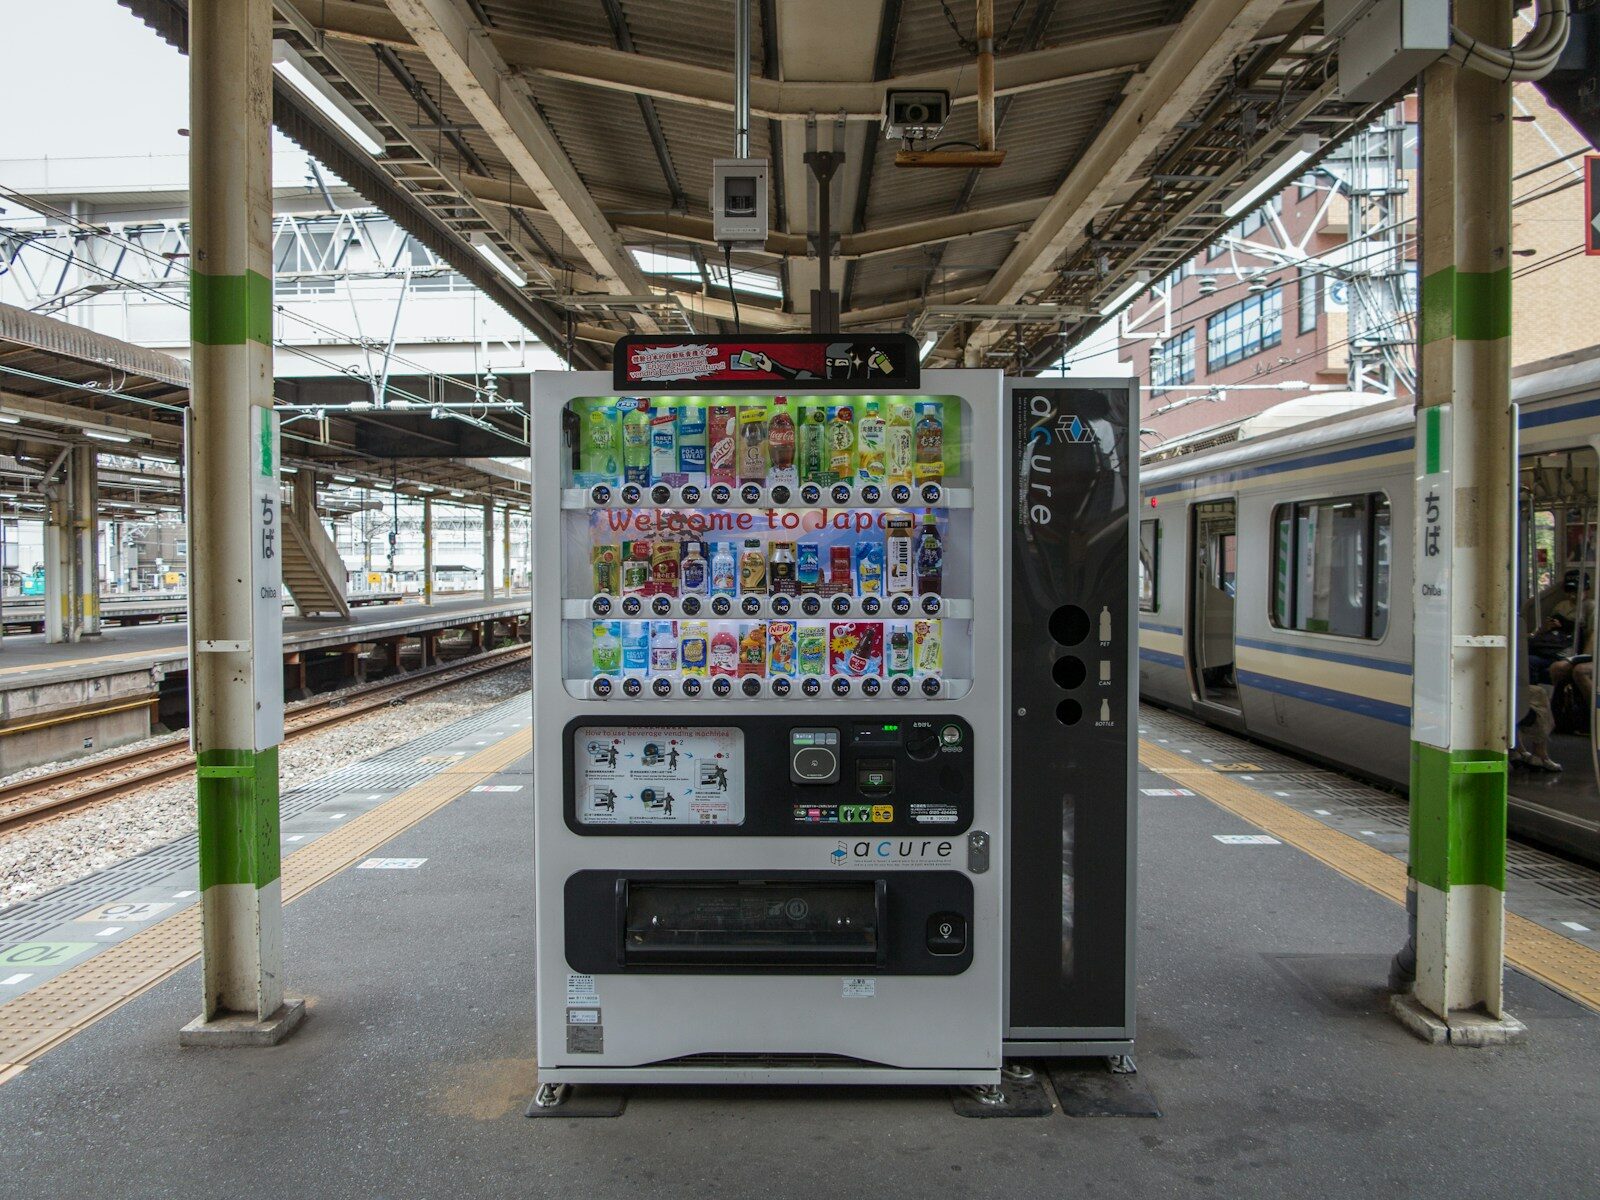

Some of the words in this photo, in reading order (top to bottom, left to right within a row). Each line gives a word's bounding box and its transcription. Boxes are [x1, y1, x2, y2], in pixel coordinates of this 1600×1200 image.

[630, 370, 661, 379] vending
[661, 366, 694, 376] machine
[1029, 395, 1052, 525] acure
[260, 494, 274, 559] ちば
[607, 508, 753, 532] Welcome
[765, 508, 800, 530] to
[1424, 491, 1441, 557] ちば
[260, 587, 277, 599] Chiba
[1421, 584, 1442, 597] Chiba
[770, 624, 789, 633] NEW
[627, 730, 661, 738] beverage
[663, 730, 693, 738] vending
[694, 730, 729, 738] machines
[853, 841, 952, 857] acure
[6, 946, 69, 963] 10
